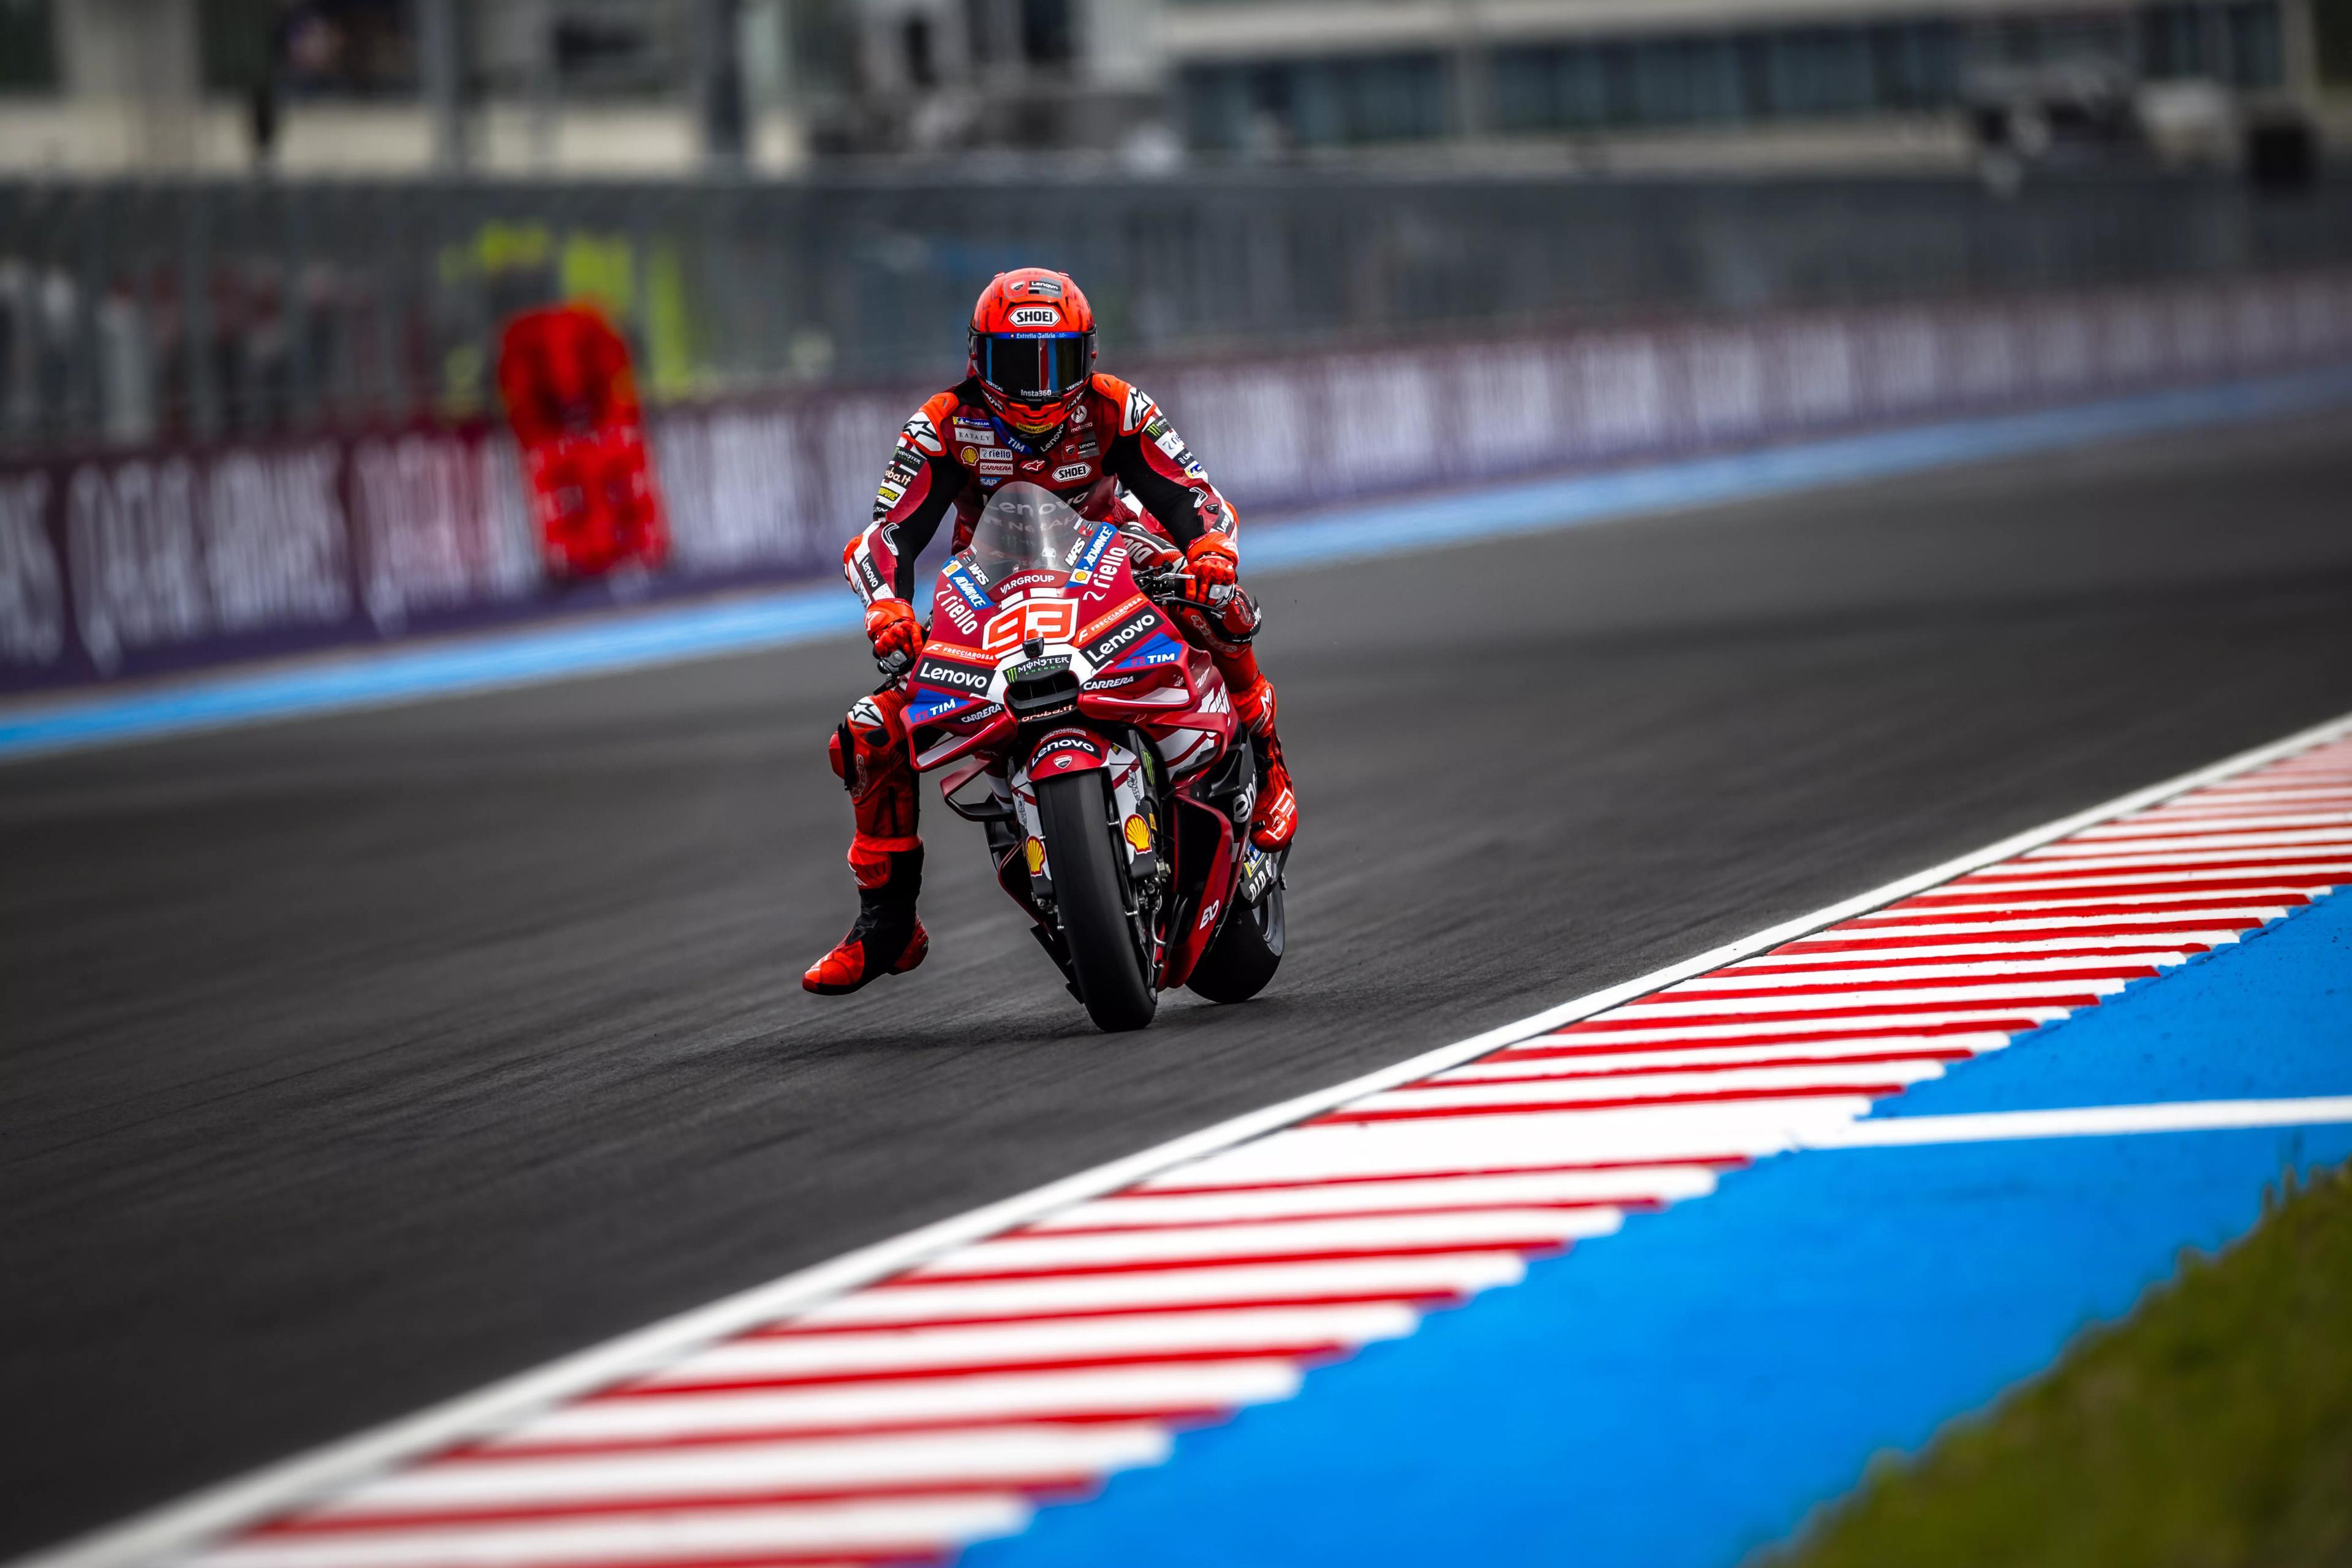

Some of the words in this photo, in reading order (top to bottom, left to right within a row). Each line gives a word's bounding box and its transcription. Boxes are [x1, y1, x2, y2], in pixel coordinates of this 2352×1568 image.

[1031, 281, 1058, 290] Lenovo
[1017, 311, 1052, 322] SHOEI
[986, 379, 1003, 393] VERTICAL
[1066, 379, 1084, 391] VERTICAL
[959, 432, 990, 441] EATALY
[1008, 437, 1025, 452] TIM
[1040, 423, 1064, 452] Lenovo
[898, 450, 921, 464] MONSTER
[989, 450, 1011, 458] riello
[1058, 466, 1087, 478] SHOEI
[1065, 537, 1085, 567] WRS
[1084, 526, 1113, 567] ADVANCE
[861, 556, 878, 587] Lenovo
[1093, 547, 1128, 589] riello
[952, 576, 986, 608] ADVANCE
[1000, 575, 1055, 595] VARGROUP
[941, 595, 978, 635] riello
[1091, 597, 1143, 631] FRECCIAROSSA
[985, 600, 1076, 657] 93
[1087, 614, 1155, 663] Lenovo
[943, 647, 993, 660] FRECCIAROSSA
[1147, 653, 1175, 664] TIM
[1018, 657, 1069, 673] MONSTER
[1026, 665, 1061, 675] ENERGY
[920, 662, 987, 688] Lenovo
[1084, 676, 1134, 690] CARRERA
[930, 698, 956, 715] TIM
[961, 703, 1002, 723] CARRERA
[1022, 704, 1073, 722] aruba.it
[1032, 739, 1095, 767] Lenovo
